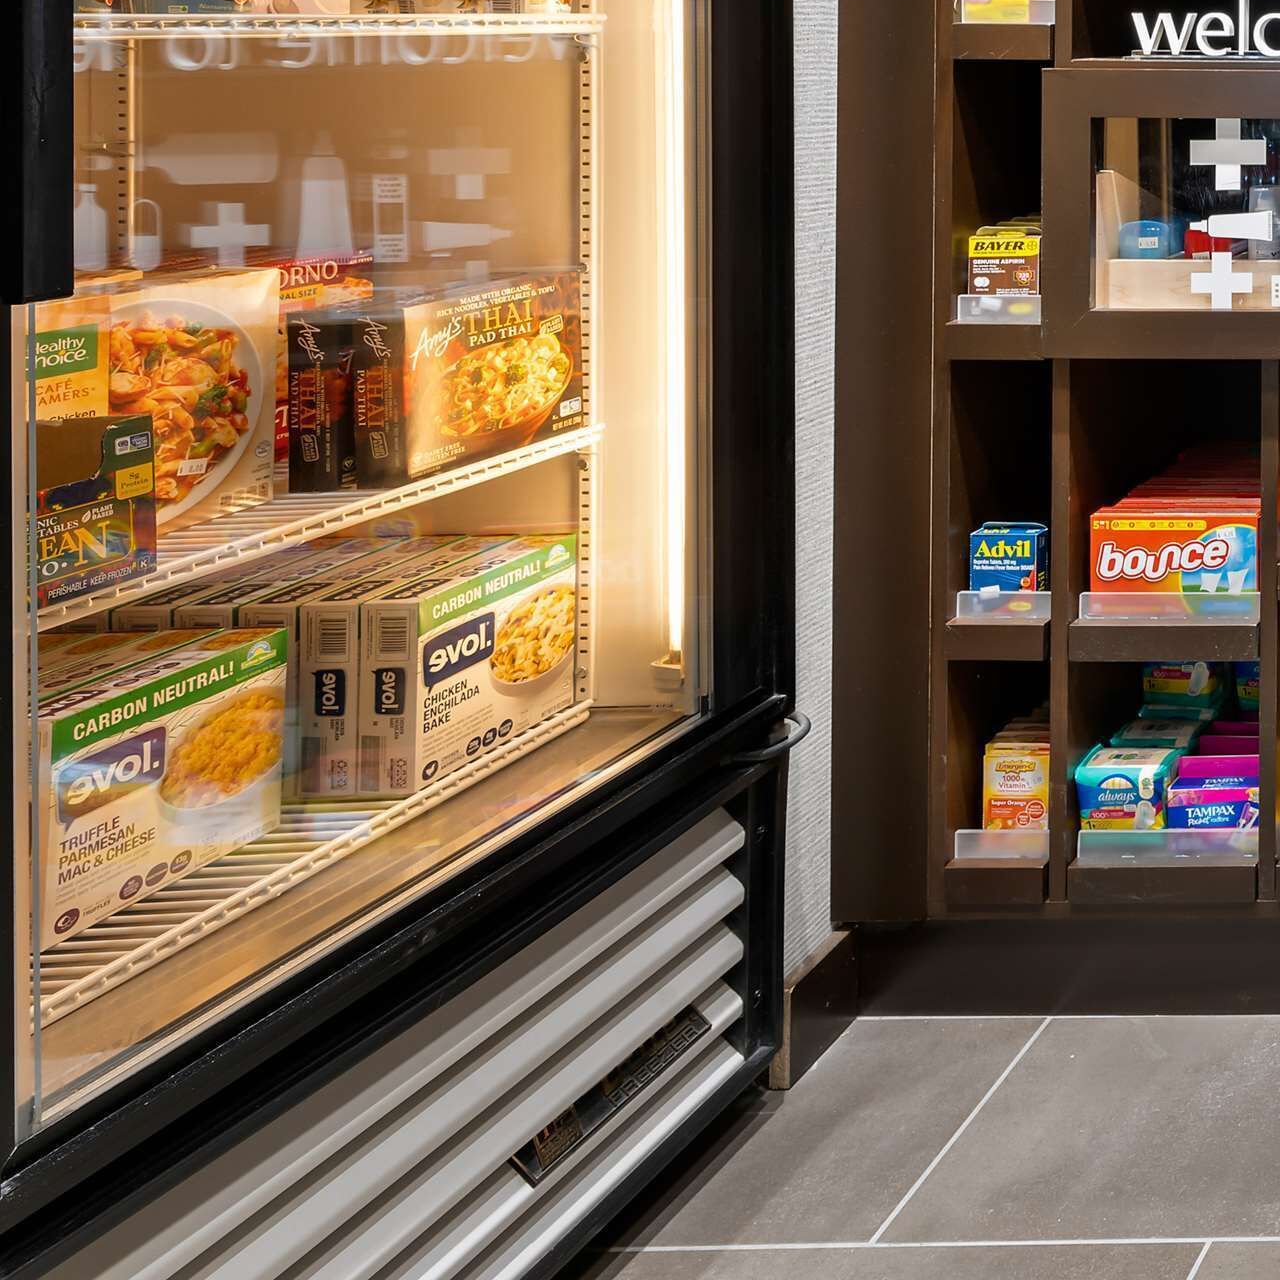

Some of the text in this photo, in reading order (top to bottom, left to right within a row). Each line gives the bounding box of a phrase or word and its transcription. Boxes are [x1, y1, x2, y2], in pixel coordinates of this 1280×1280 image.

[973, 241, 1025, 251] BAYER
[463, 299, 534, 336] THAI
[469, 322, 532, 347] PAD THAI
[410, 314, 464, 370] Amy's
[974, 539, 1031, 558] Advil
[1096, 538, 1232, 583] bounce
[432, 559, 541, 619] CARBON NEUTRAL!
[428, 623, 492, 673] evol.
[72, 661, 235, 742] CARBON NEUTRAL!
[423, 679, 468, 709] CHICKEN
[423, 685, 480, 721] ENCHILADA
[423, 712, 452, 734] BAKE
[66, 740, 161, 806] evol.
[1098, 790, 1138, 804] always
[1185, 805, 1235, 818] TAMPAX
[57, 823, 137, 869] PARMESAN
[58, 816, 121, 854] TRUFFLE
[57, 861, 91, 886] MAC
[93, 852, 105, 869] &
[106, 827, 156, 863] CHEESE
